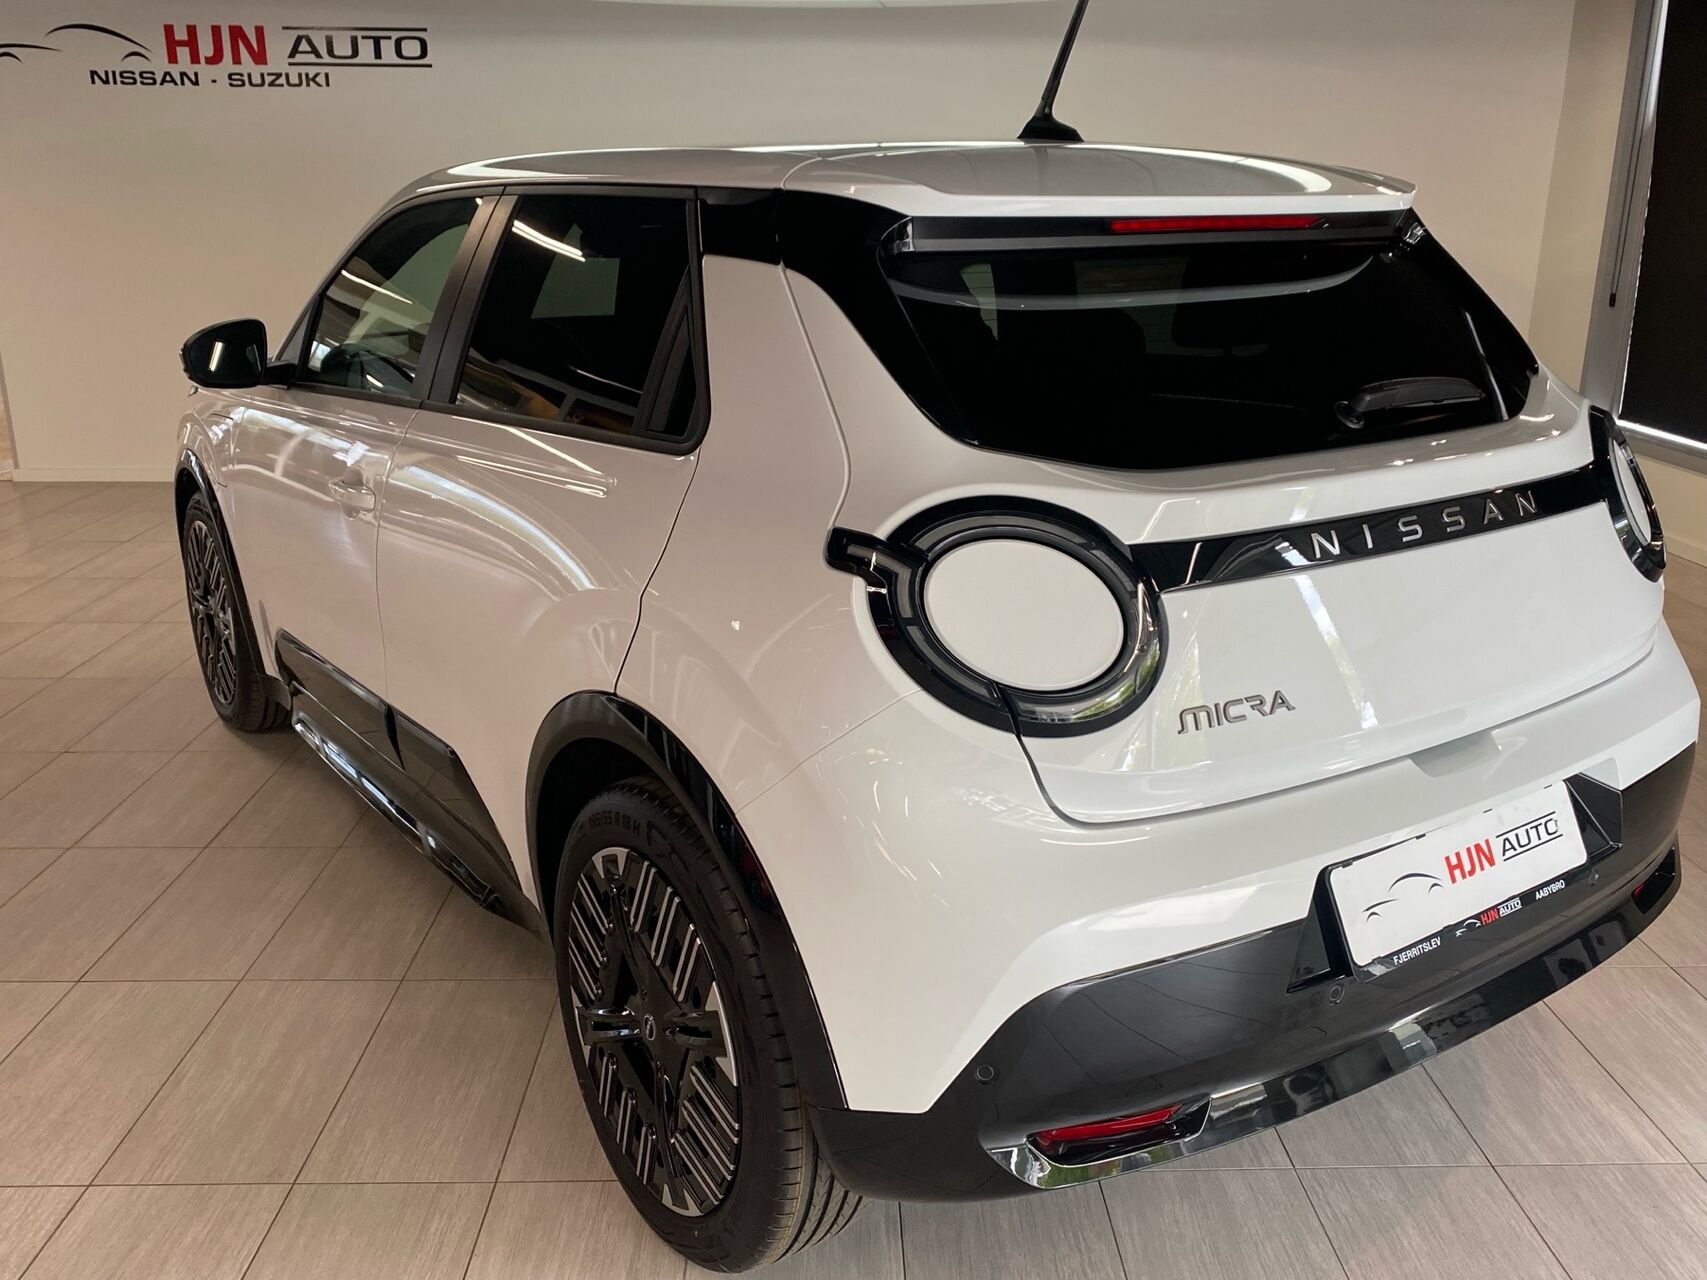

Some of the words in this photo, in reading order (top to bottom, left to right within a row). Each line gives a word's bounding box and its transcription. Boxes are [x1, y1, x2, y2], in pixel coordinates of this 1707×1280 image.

[163, 24, 268, 65] HJN
[287, 34, 429, 60] AUTO
[89, 69, 200, 87] NISSAN
[227, 71, 330, 88] SUZUKI
[1311, 490, 1537, 559] NISSAN
[1177, 690, 1296, 734] MICRA
[1444, 838, 1496, 884] HJN
[1502, 817, 1559, 857] AUTO
[1393, 936, 1441, 966] FJERRITSLEV
[1480, 908, 1499, 925] HJN
[1499, 899, 1522, 916] AUTO
[1535, 879, 1565, 900] AABYBRO
